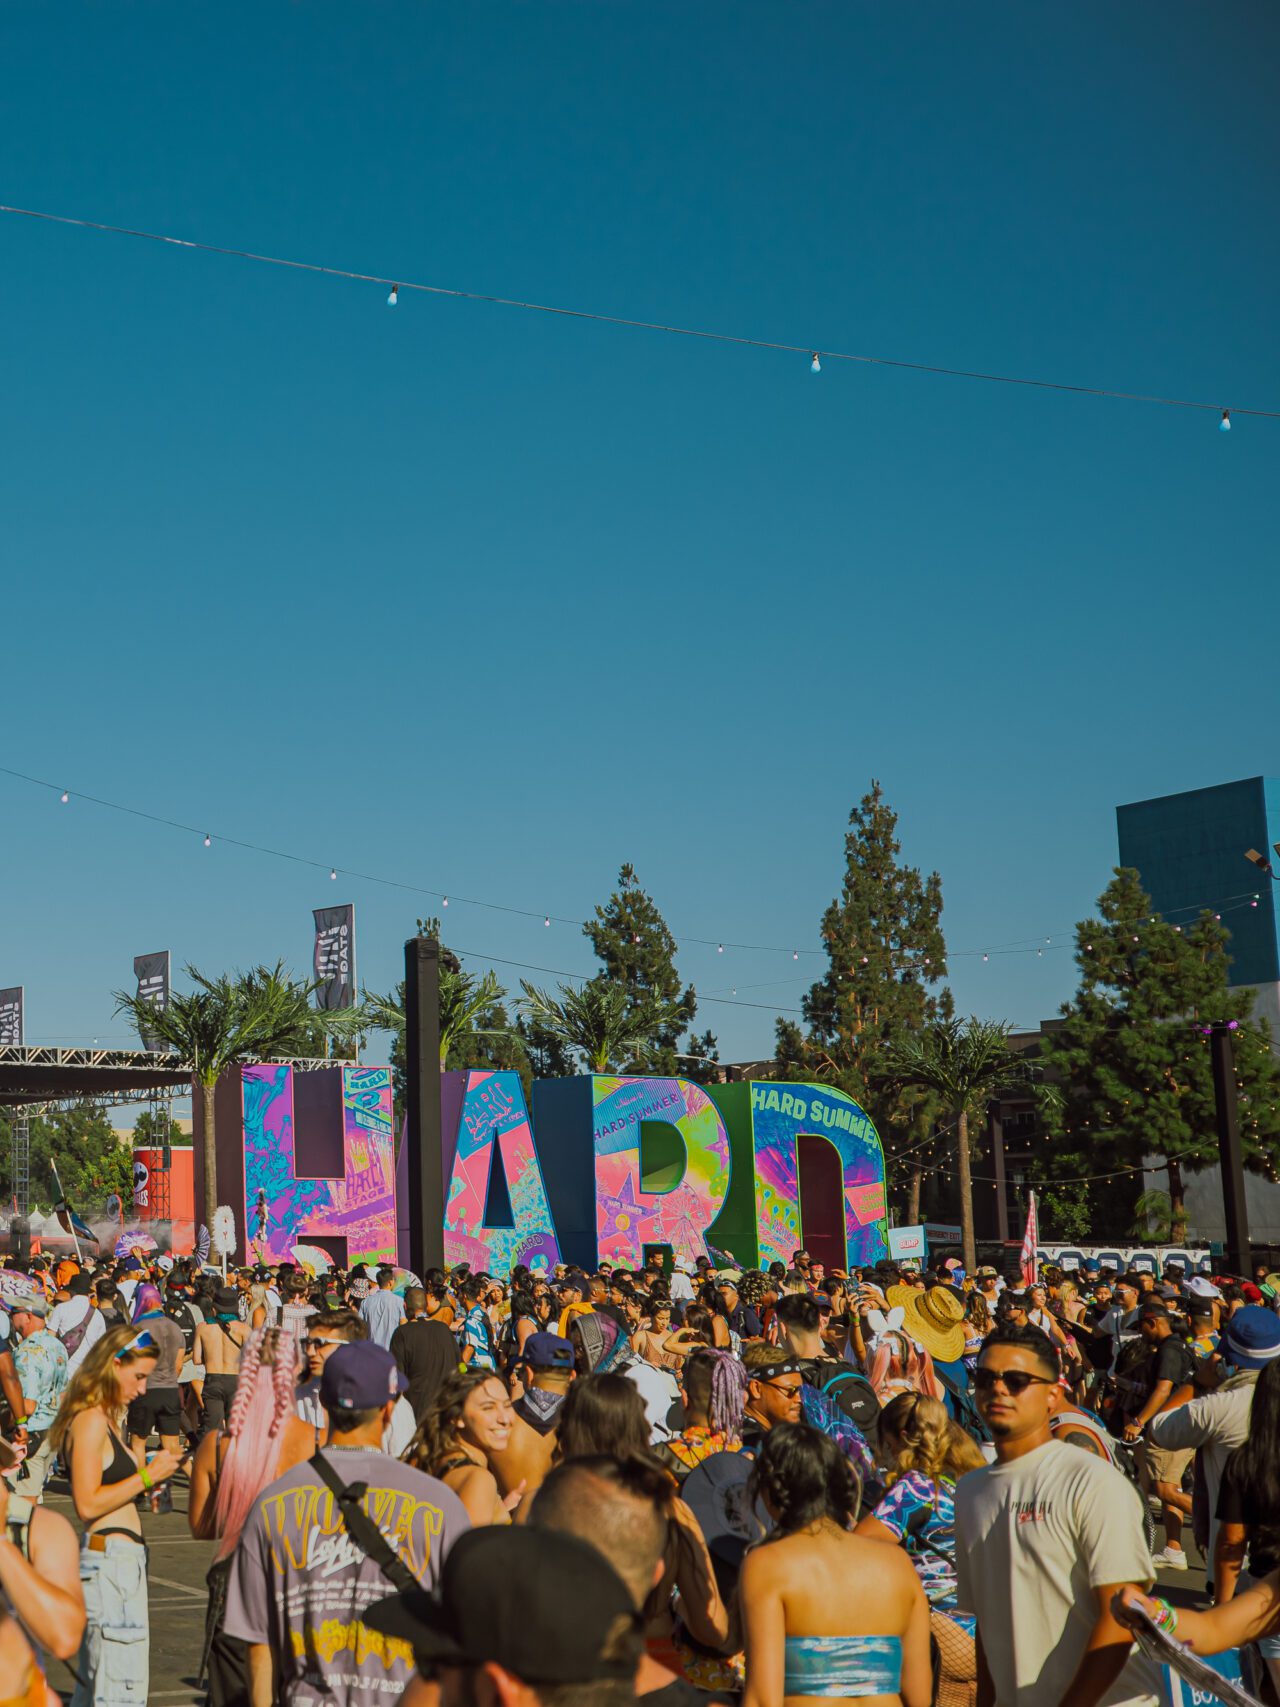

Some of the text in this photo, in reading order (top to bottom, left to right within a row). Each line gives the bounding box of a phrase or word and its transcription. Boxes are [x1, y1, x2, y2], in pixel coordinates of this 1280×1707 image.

[350, 1070, 387, 1089] HARD
[593, 1092, 681, 1142] HARD SUMMER
[751, 1088, 807, 1120] HARD
[515, 1233, 544, 1258] HARD
[260, 1484, 444, 1582] WOVES
